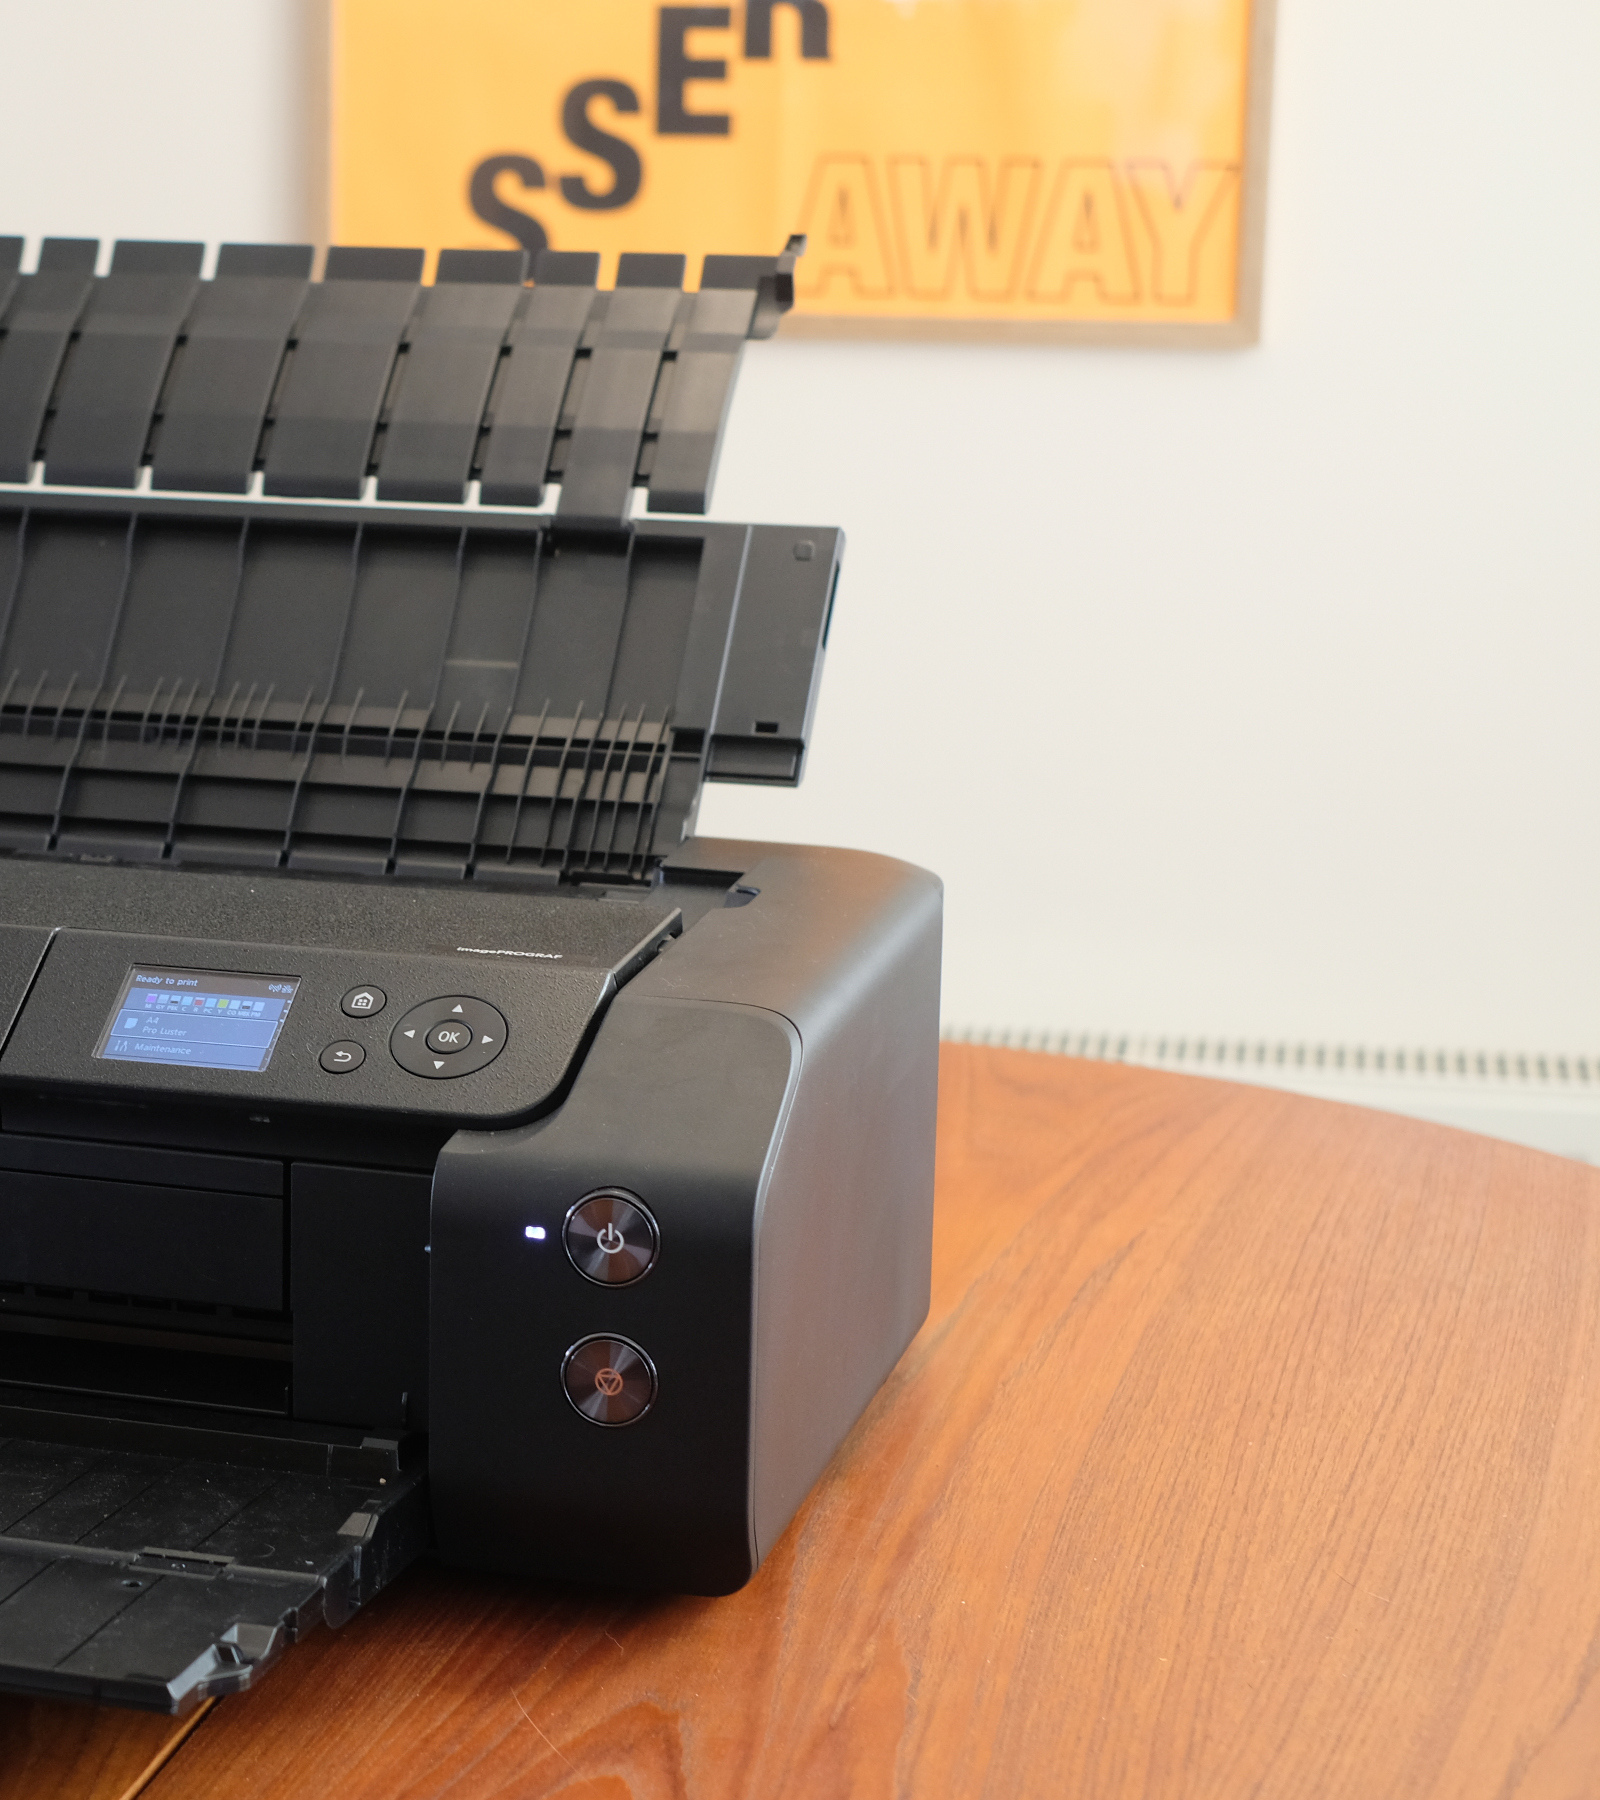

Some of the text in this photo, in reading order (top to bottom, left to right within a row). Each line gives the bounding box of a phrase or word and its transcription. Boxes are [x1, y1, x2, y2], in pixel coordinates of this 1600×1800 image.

[793, 151, 1242, 306] AWAY
[457, 946, 563, 959] imagePROGRAF
[135, 974, 199, 988] Ready to print
[145, 1016, 160, 1025] A4
[142, 1026, 188, 1037] Pro Luster
[438, 1031, 460, 1044] OK
[134, 1043, 192, 1055] Maintenance
